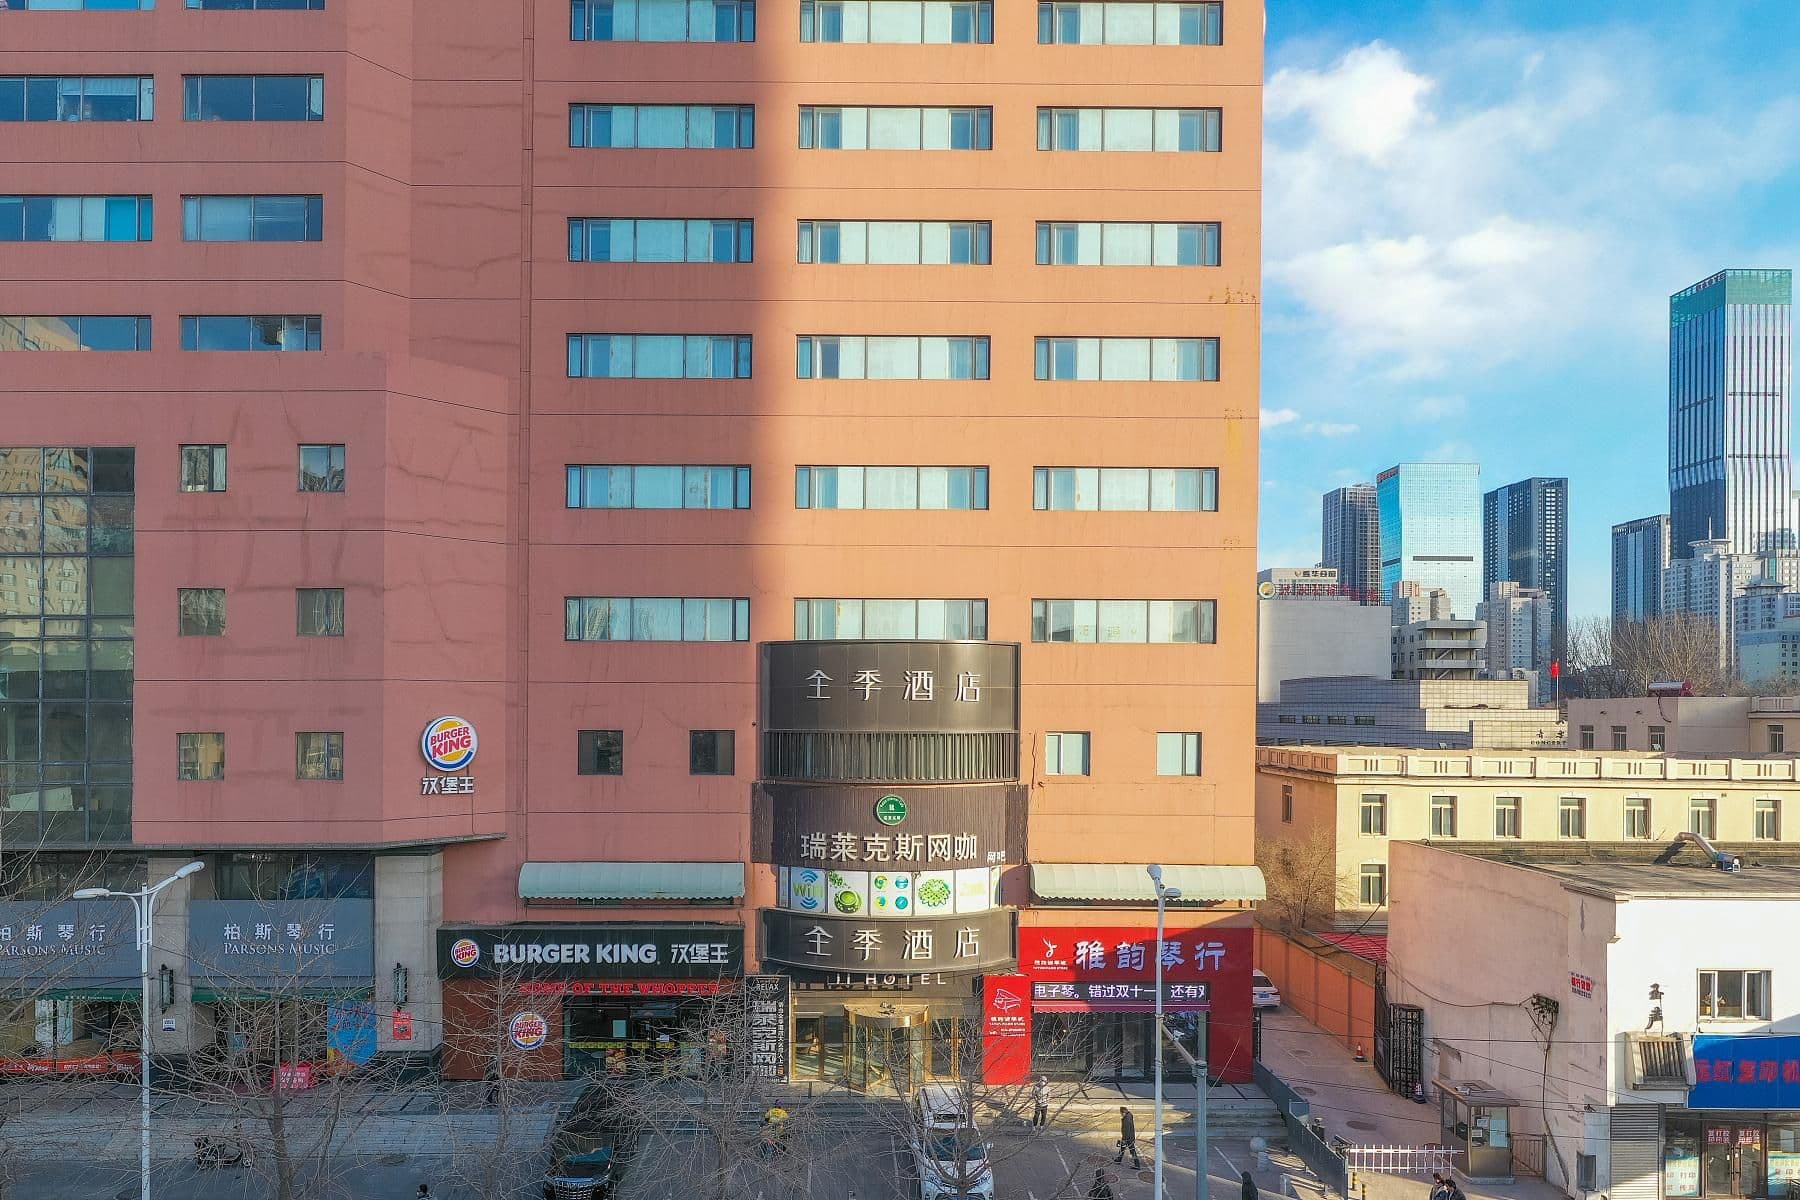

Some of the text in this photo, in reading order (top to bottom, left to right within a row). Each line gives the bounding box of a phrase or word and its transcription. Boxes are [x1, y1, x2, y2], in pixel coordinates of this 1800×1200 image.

[805, 668, 981, 702] 全季酒店
[430, 726, 470, 746] BURGER
[432, 735, 472, 759] KING
[422, 776, 475, 795] 汉堡王
[800, 831, 977, 862] 瑞莱克斯网咖
[223, 923, 335, 941] 柏斯琴行
[61, 943, 106, 956] MUSIC
[223, 942, 336, 956] PARSONS MUSIC
[804, 925, 980, 961] 全季酒店
[455, 949, 477, 961] KING
[493, 943, 729, 964] BURGER KING 汉堡王
[1074, 939, 1226, 972] 雅韵琴行
[756, 983, 779, 991] RELAX
[865, 972, 947, 986] HOTEL
[572, 983, 595, 994] OF
[599, 983, 634, 994] THE
[637, 982, 720, 995] WHOPPER
[514, 1026, 543, 1039] KING
